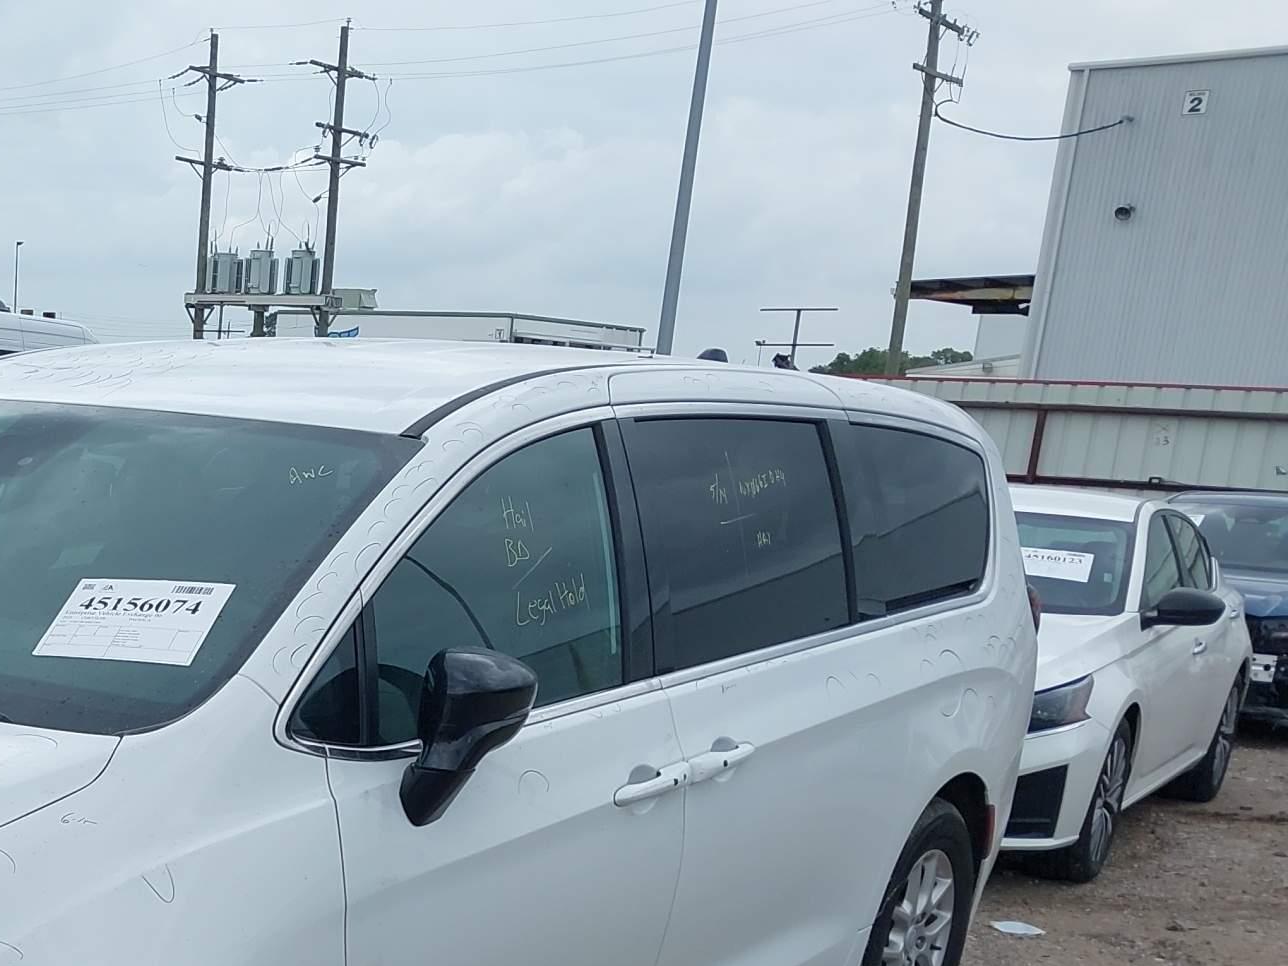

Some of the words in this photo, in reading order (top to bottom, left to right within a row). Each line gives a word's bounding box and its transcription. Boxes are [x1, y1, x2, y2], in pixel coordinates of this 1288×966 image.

[1187, 96, 1204, 113] 2
[500, 495, 534, 532] Hail
[79, 596, 203, 615] 45156074
[516, 590, 557, 626] Legal
[554, 572, 590, 609] Hold
